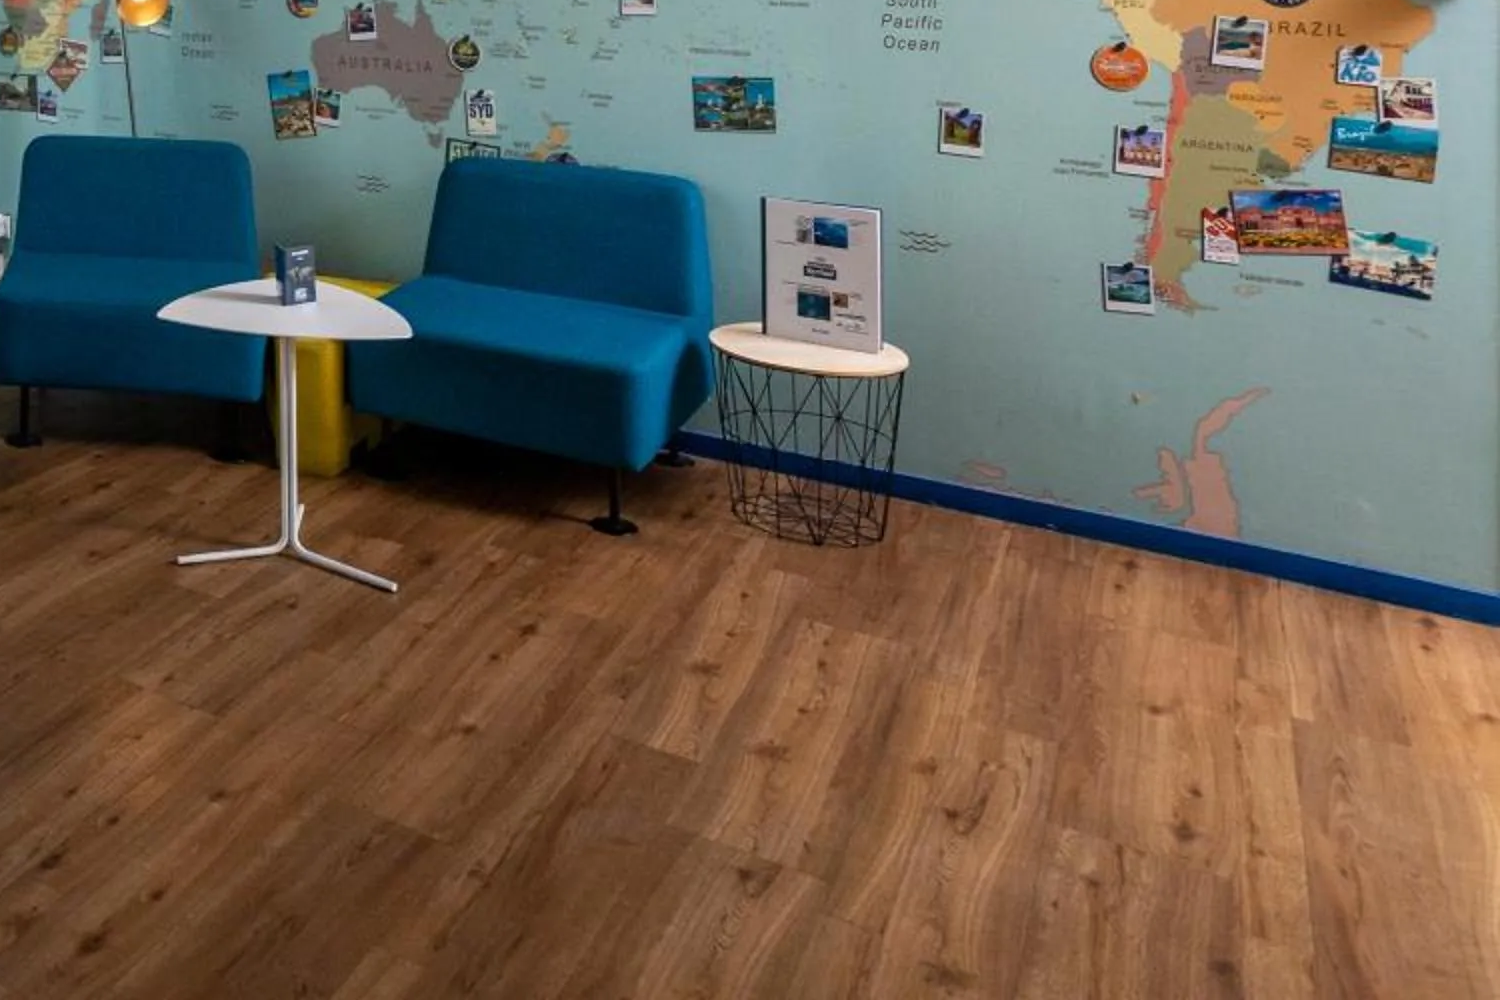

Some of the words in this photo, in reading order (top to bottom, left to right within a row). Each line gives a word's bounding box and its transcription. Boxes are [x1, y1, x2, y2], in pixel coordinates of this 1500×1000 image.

[1113, 0, 1146, 10] PERU
[880, 13, 944, 31] Pacific
[882, 34, 941, 53] Ocean
[337, 55, 434, 73] AUSTRALIA
[468, 102, 494, 119] SYD
[1180, 138, 1255, 153] ARGENTINA
